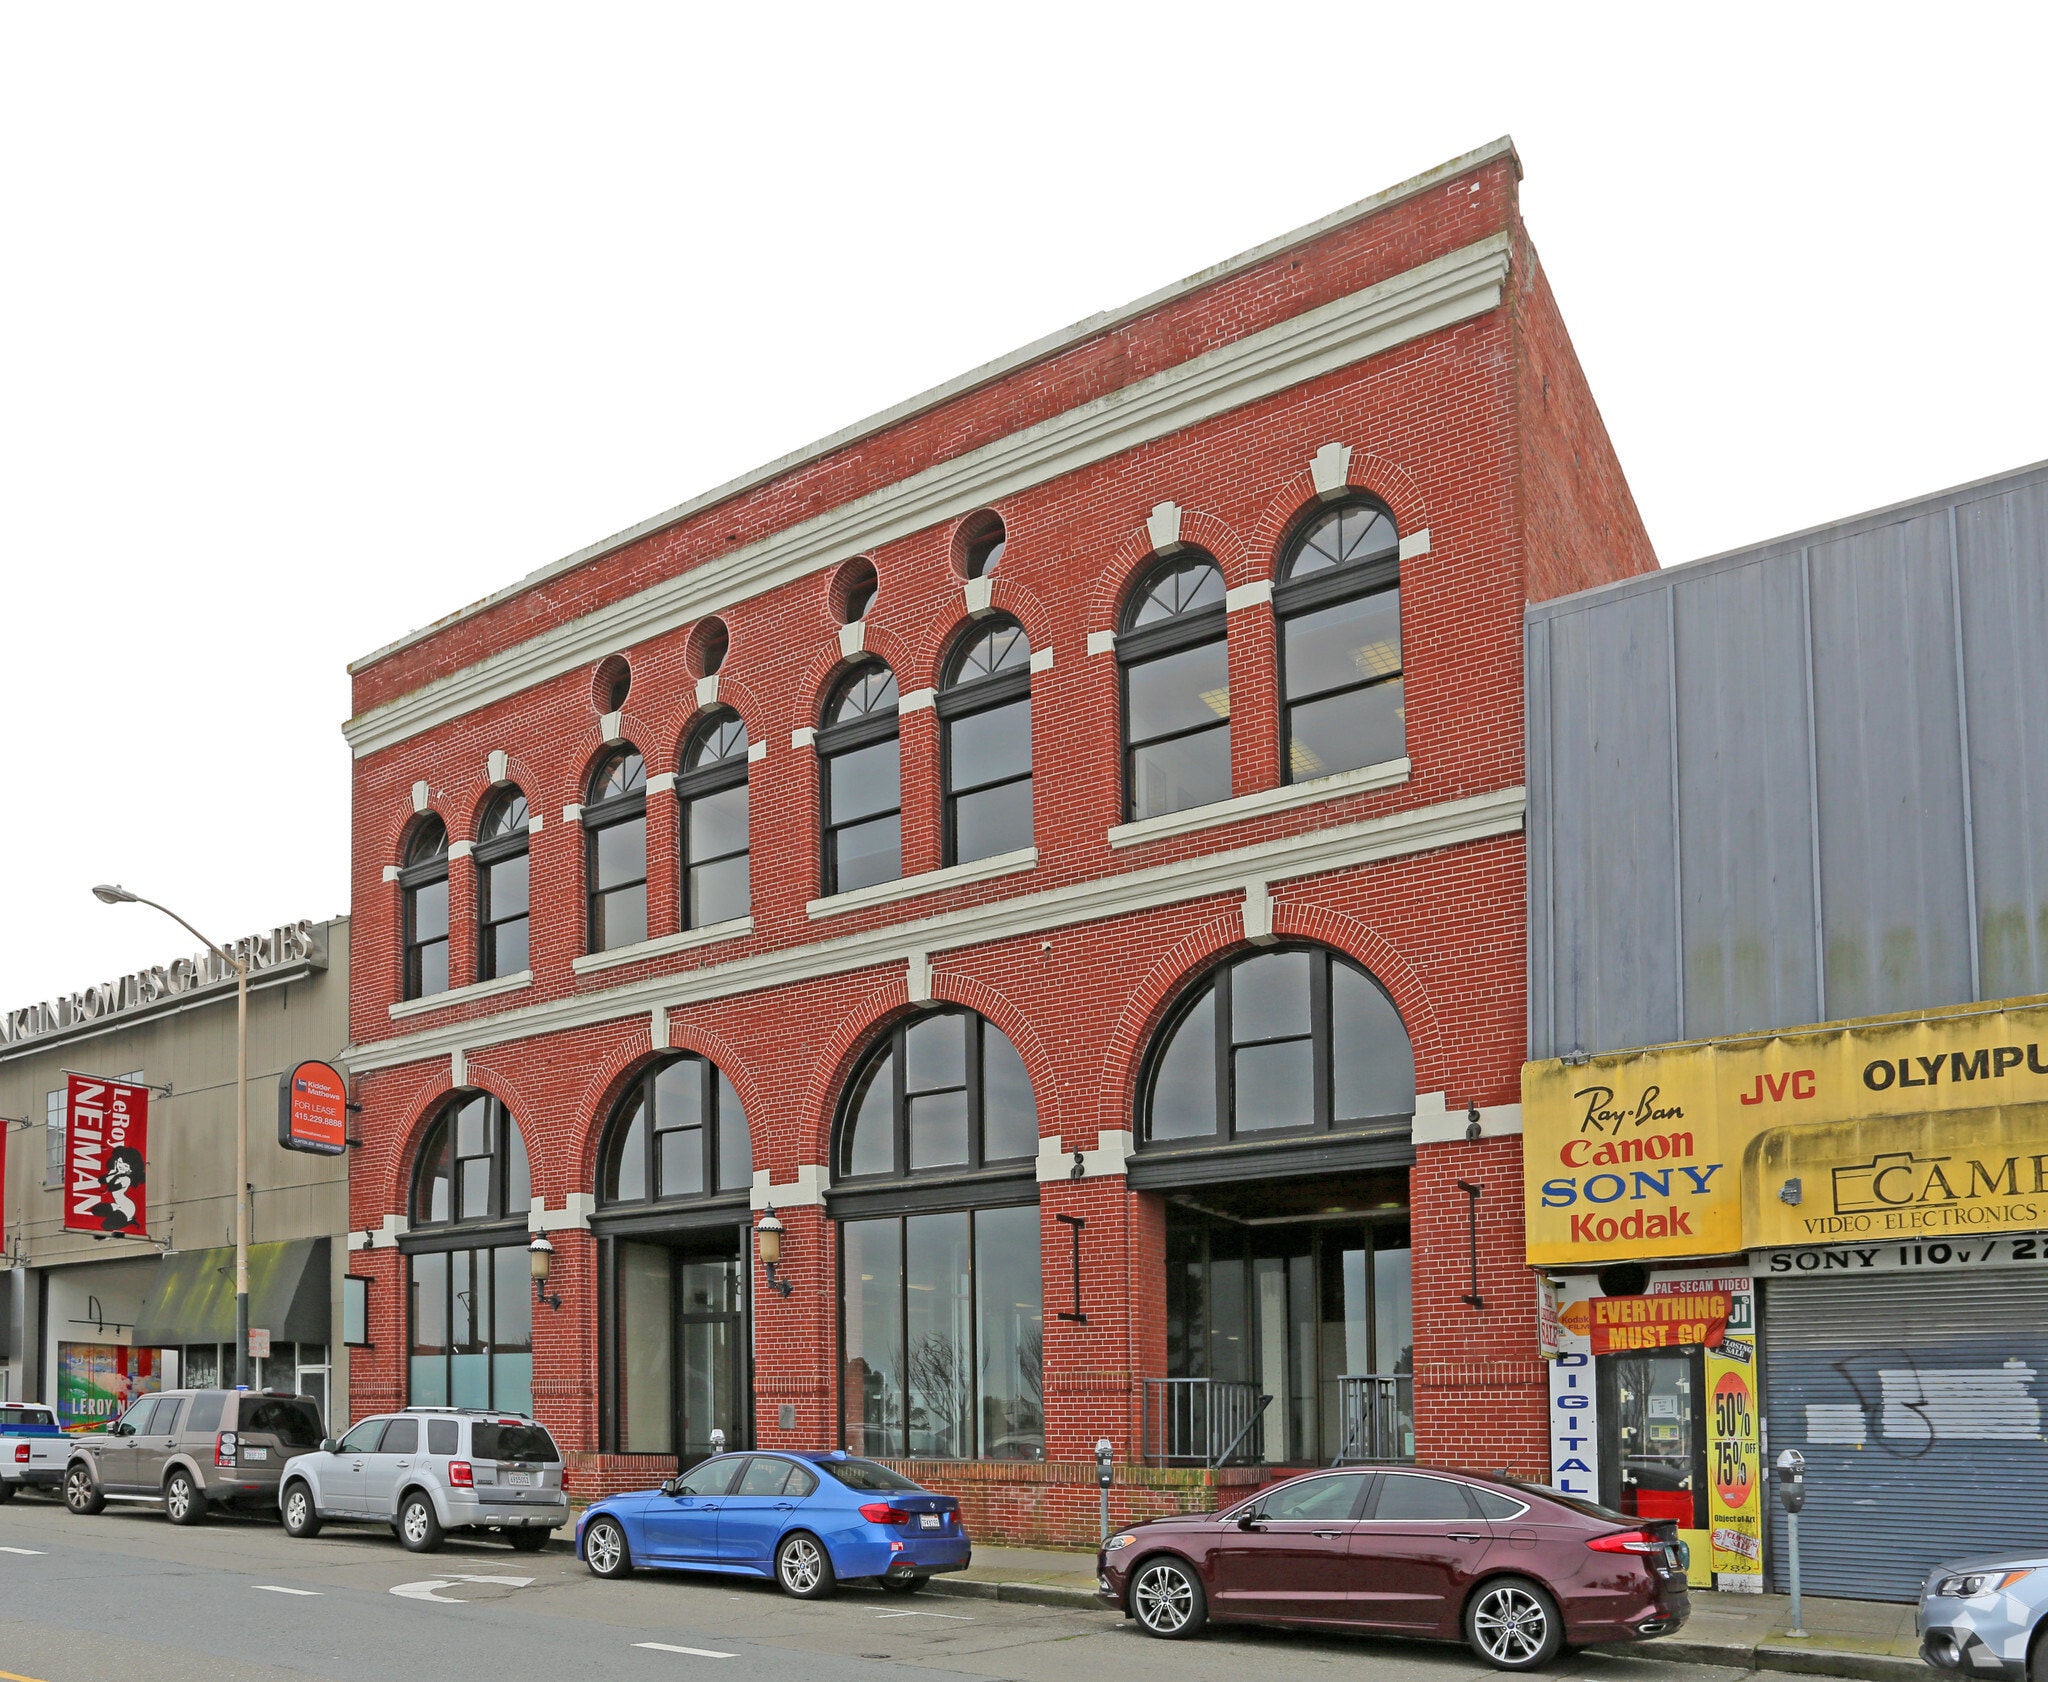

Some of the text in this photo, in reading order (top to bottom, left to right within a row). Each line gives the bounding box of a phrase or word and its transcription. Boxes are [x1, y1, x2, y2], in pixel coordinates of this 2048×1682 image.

[70, 965, 164, 1026] BOWLES
[167, 918, 314, 995] GALLERIES
[1862, 1043, 2048, 1091] OLYMPU
[307, 1081, 331, 1092] Kidder
[307, 1088, 340, 1101] Mathews
[1740, 1069, 1816, 1105] JVC
[107, 1087, 132, 1148] LeRoy
[294, 1100, 336, 1116] FOR LEASE
[294, 1111, 342, 1128] 415.229.8888
[73, 1080, 105, 1216] NEIMAN
[1560, 1132, 1693, 1168] Canon
[1541, 1164, 1723, 1207] SONY
[1570, 1206, 1693, 1243] Kodak
[1803, 1203, 2037, 1235] VIDEO ELECTRONICS
[1770, 1248, 1881, 1272] SONY
[2011, 1238, 2048, 1260] 2
[1655, 1278, 1748, 1295] PAL-SECAM VIDEO
[1561, 1315, 1590, 1324] Kodak
[1596, 1295, 1725, 1324] EVERYTHING
[1608, 1324, 1707, 1350] MUST GO
[1722, 1339, 1752, 1353] CLOSING
[1726, 1347, 1745, 1357] SALE
[72, 1398, 113, 1415] LEROY
[1716, 1391, 1750, 1437] 50%
[1556, 1353, 1592, 1493] DIGITAL
[1715, 1441, 1746, 1485] 75%
[1745, 1443, 1756, 1454] OFF
[1714, 1514, 1736, 1523] Object
[1737, 1515, 1745, 1523] of
